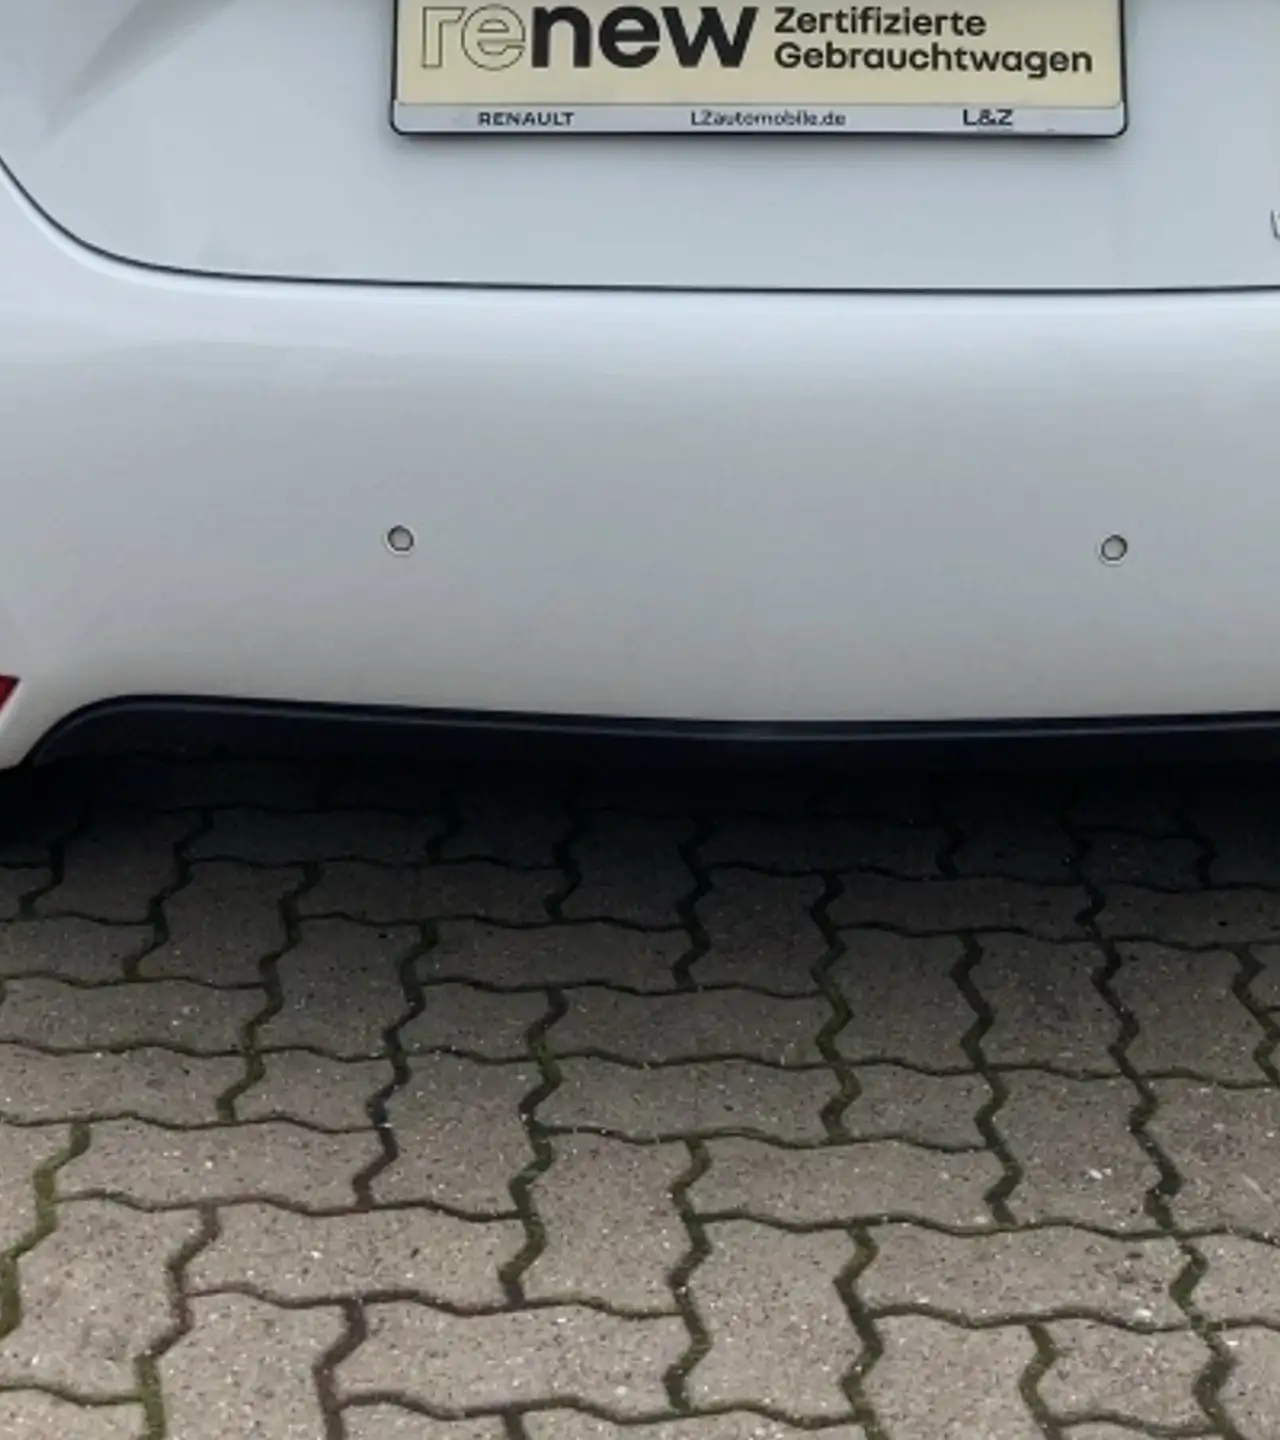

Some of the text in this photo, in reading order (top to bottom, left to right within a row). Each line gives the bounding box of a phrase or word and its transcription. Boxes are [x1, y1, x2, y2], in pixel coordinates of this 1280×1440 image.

[420, 3, 760, 71] renew
[773, 6, 988, 36] Zertifizierte
[773, 41, 1093, 79] Gebrauchtwagen
[477, 109, 1014, 127] RENAULT LZautomobile.de L&Z
